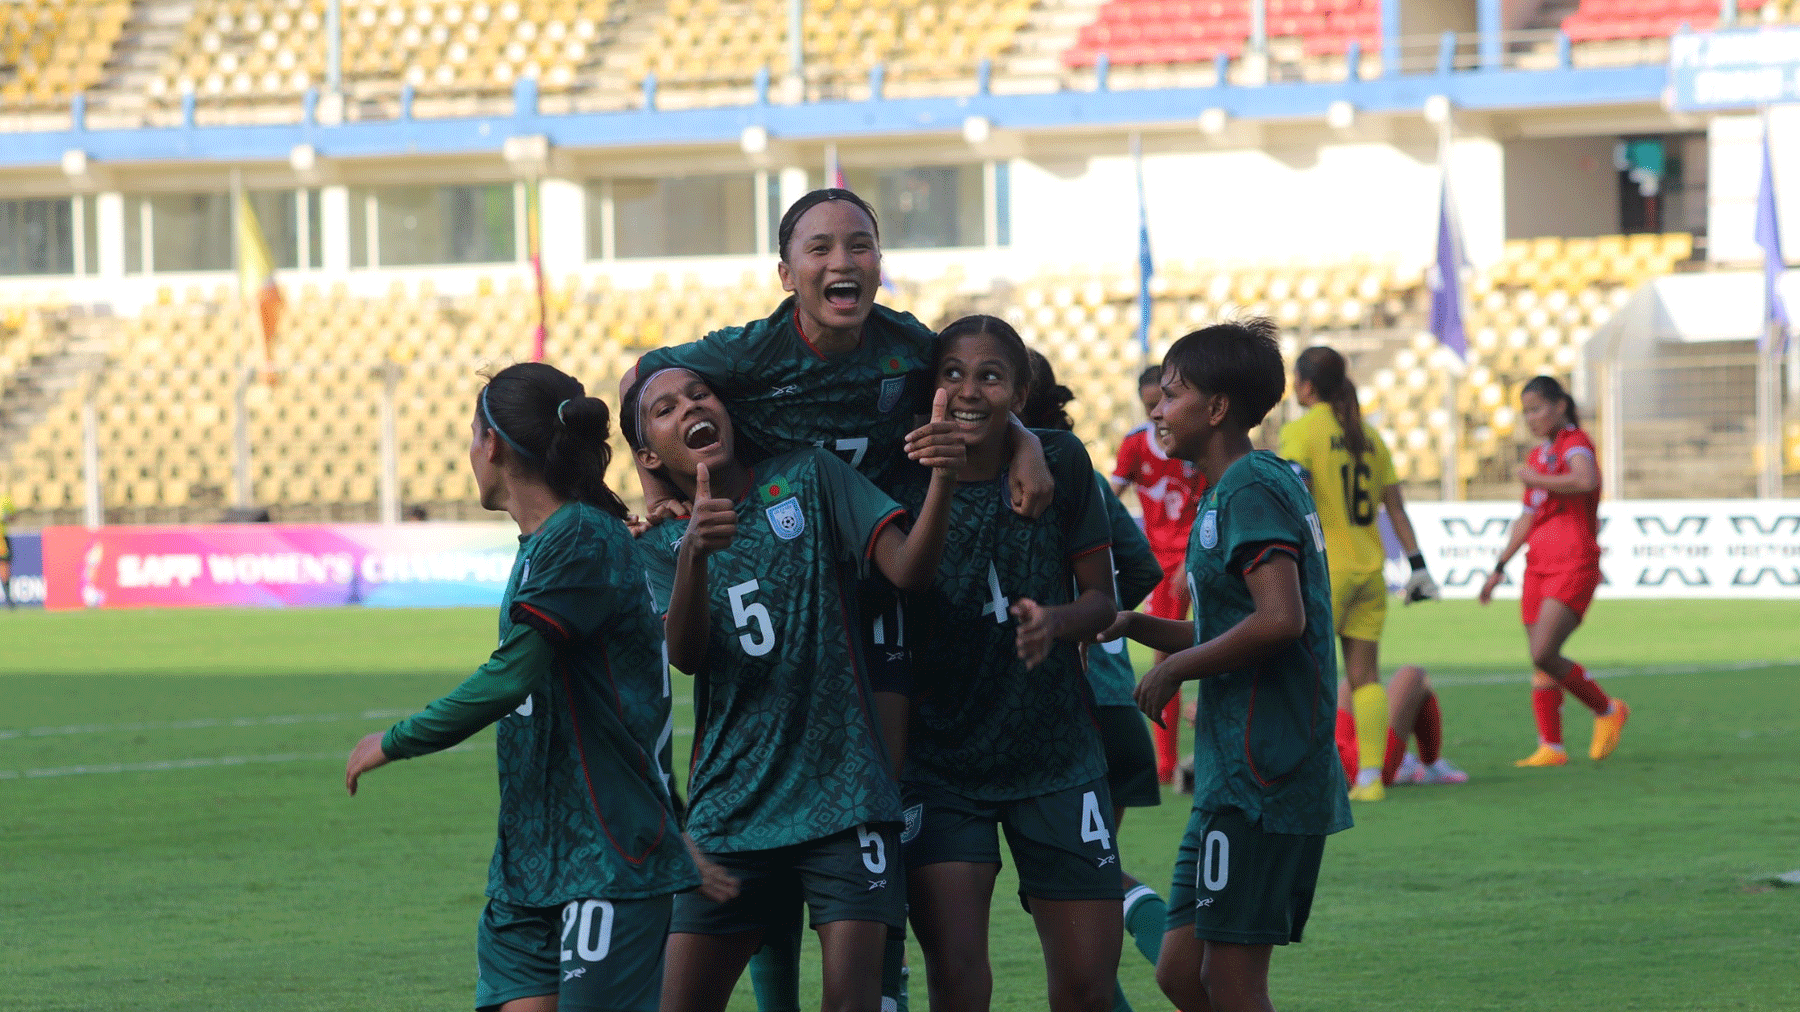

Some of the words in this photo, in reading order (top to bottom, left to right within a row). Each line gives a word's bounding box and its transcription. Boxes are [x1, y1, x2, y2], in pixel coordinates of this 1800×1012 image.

[1341, 464, 1374, 527] 16
[727, 579, 776, 657] 5
[981, 559, 1010, 624] 4
[856, 823, 887, 874] 5
[1081, 791, 1111, 850] 4
[560, 899, 614, 962] 20
